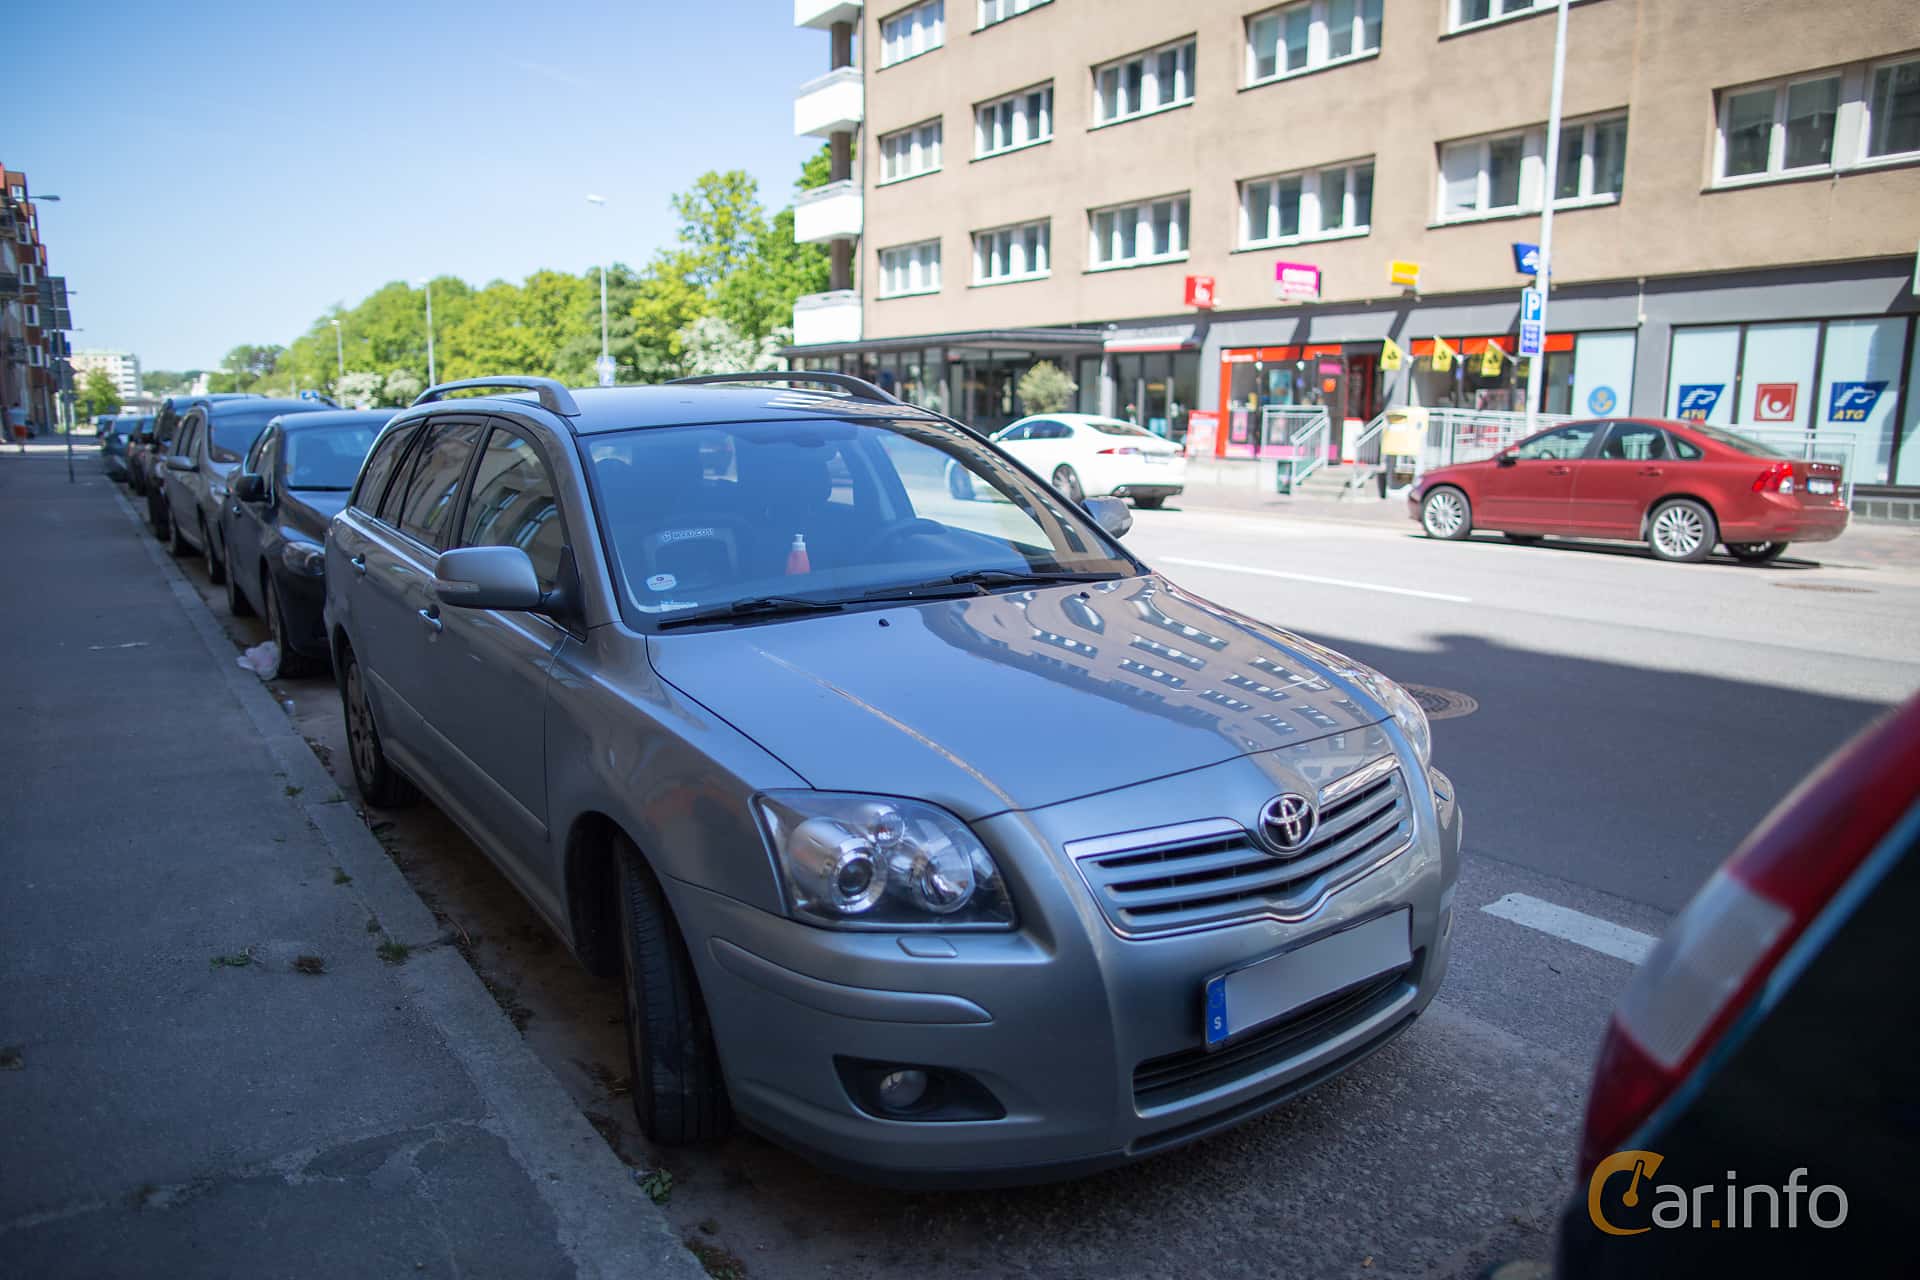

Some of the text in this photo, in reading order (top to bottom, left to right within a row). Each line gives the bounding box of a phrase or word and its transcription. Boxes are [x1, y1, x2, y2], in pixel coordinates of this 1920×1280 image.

[1527, 292, 1540, 320] P
[1832, 409, 1865, 420] ATG
[1213, 1015, 1222, 1030] S
